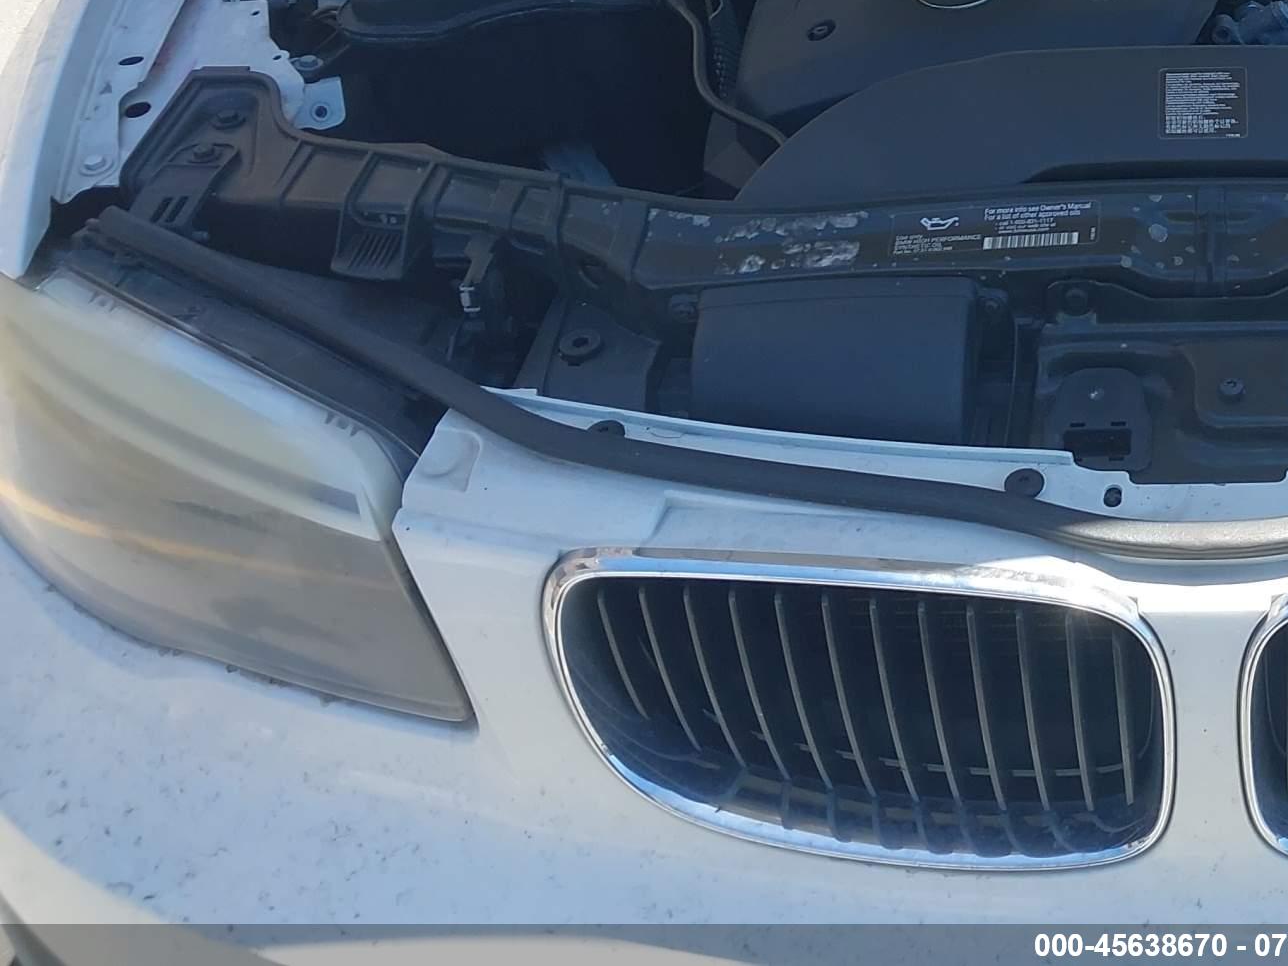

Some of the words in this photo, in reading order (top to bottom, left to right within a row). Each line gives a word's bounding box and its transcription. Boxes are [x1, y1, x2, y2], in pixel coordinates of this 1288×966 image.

[1040, 204, 1066, 212] Owner's
[1068, 202, 1092, 210] Manual
[1038, 210, 1069, 218] approved
